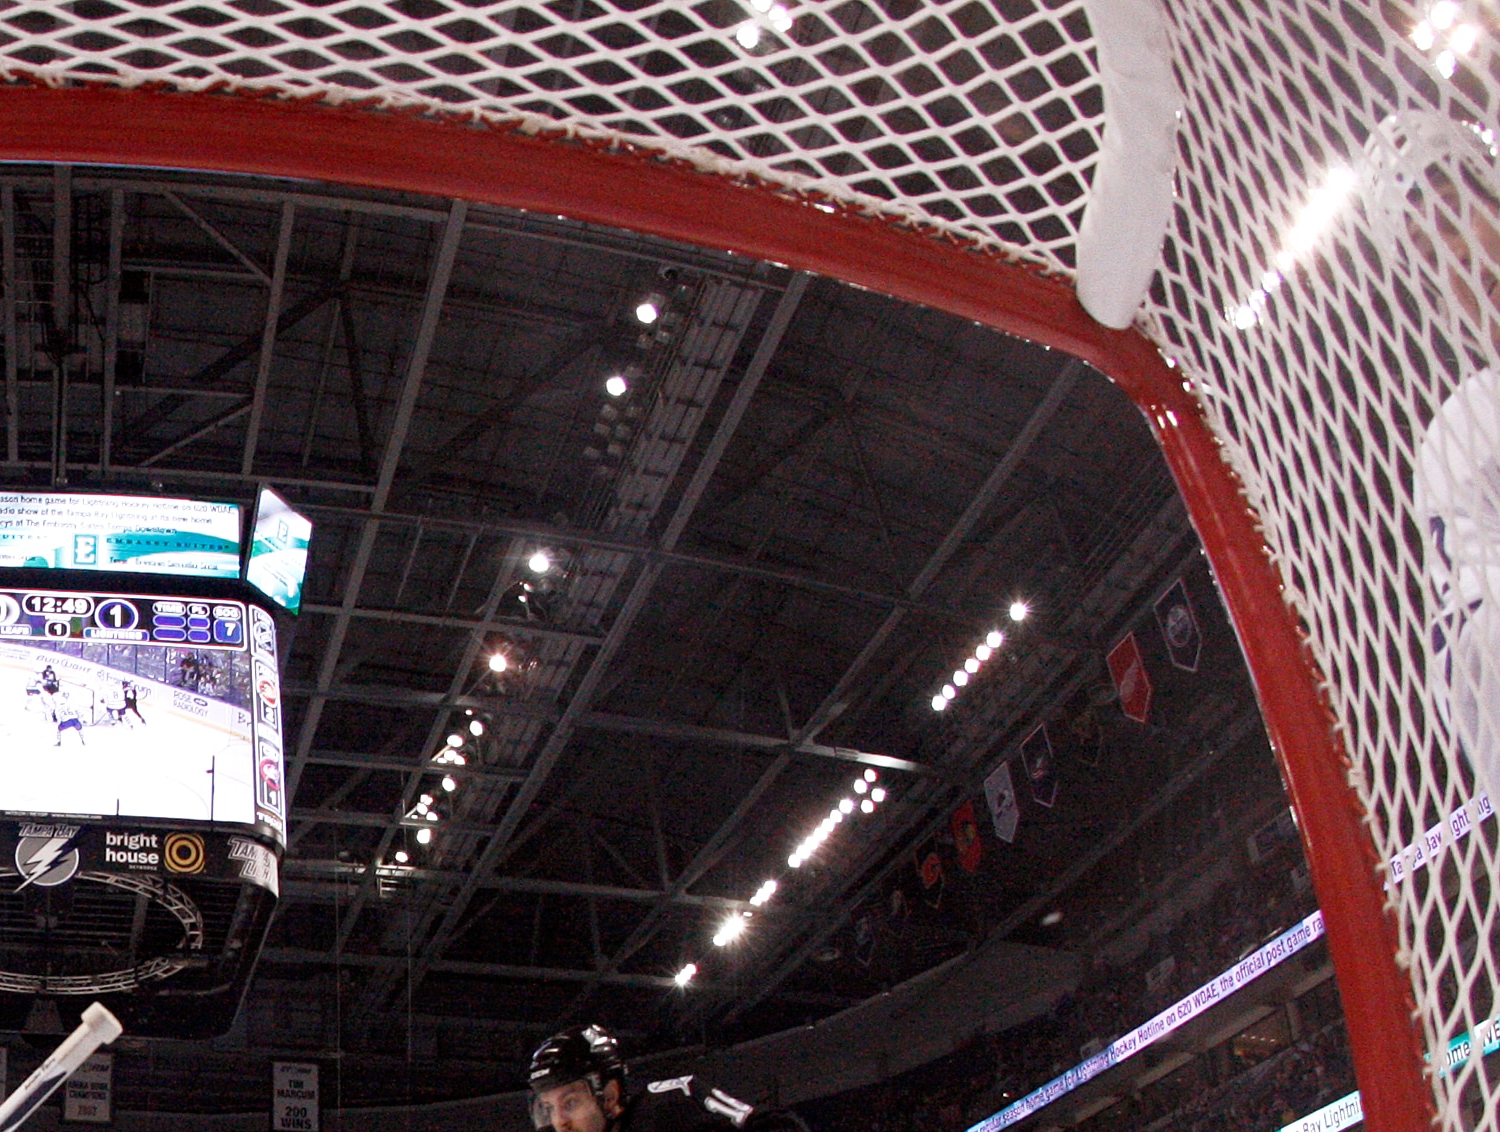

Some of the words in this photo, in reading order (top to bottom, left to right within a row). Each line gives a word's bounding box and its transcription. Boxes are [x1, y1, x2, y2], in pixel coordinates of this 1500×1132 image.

[20, 495, 42, 504] home
[45, 497, 66, 507] game
[18, 506, 39, 517] show
[31, 597, 88, 614] 12:49
[110, 604, 122, 628] 1
[156, 603, 184, 613] TIME
[191, 605, 206, 614] PL
[54, 625, 62, 635] 1
[91, 629, 142, 641] LIGHTNING
[225, 622, 237, 637] 7
[19, 822, 53, 838] TAMPA
[54, 823, 81, 839] BAY
[105, 832, 158, 850] bright
[105, 847, 160, 865] house
[1001, 1103, 1026, 1124] season
[1044, 1081, 1065, 1101] game
[1064, 1071, 1077, 1088] for
[1076, 1053, 1110, 1080] Lightning
[1110, 1037, 1138, 1062] Hockey
[1137, 1019, 1165, 1042] Hotline
[1166, 1014, 1177, 1027] on
[1176, 1000, 1192, 1020] 620
[1191, 984, 1220, 1010] WDAE,
[1219, 975, 1234, 992] the
[1235, 955, 1266, 983] official
[1265, 940, 1286, 967] post
[1286, 925, 1312, 951] game
[284, 1105, 308, 1118] 200
[280, 1117, 312, 1130] WINS
